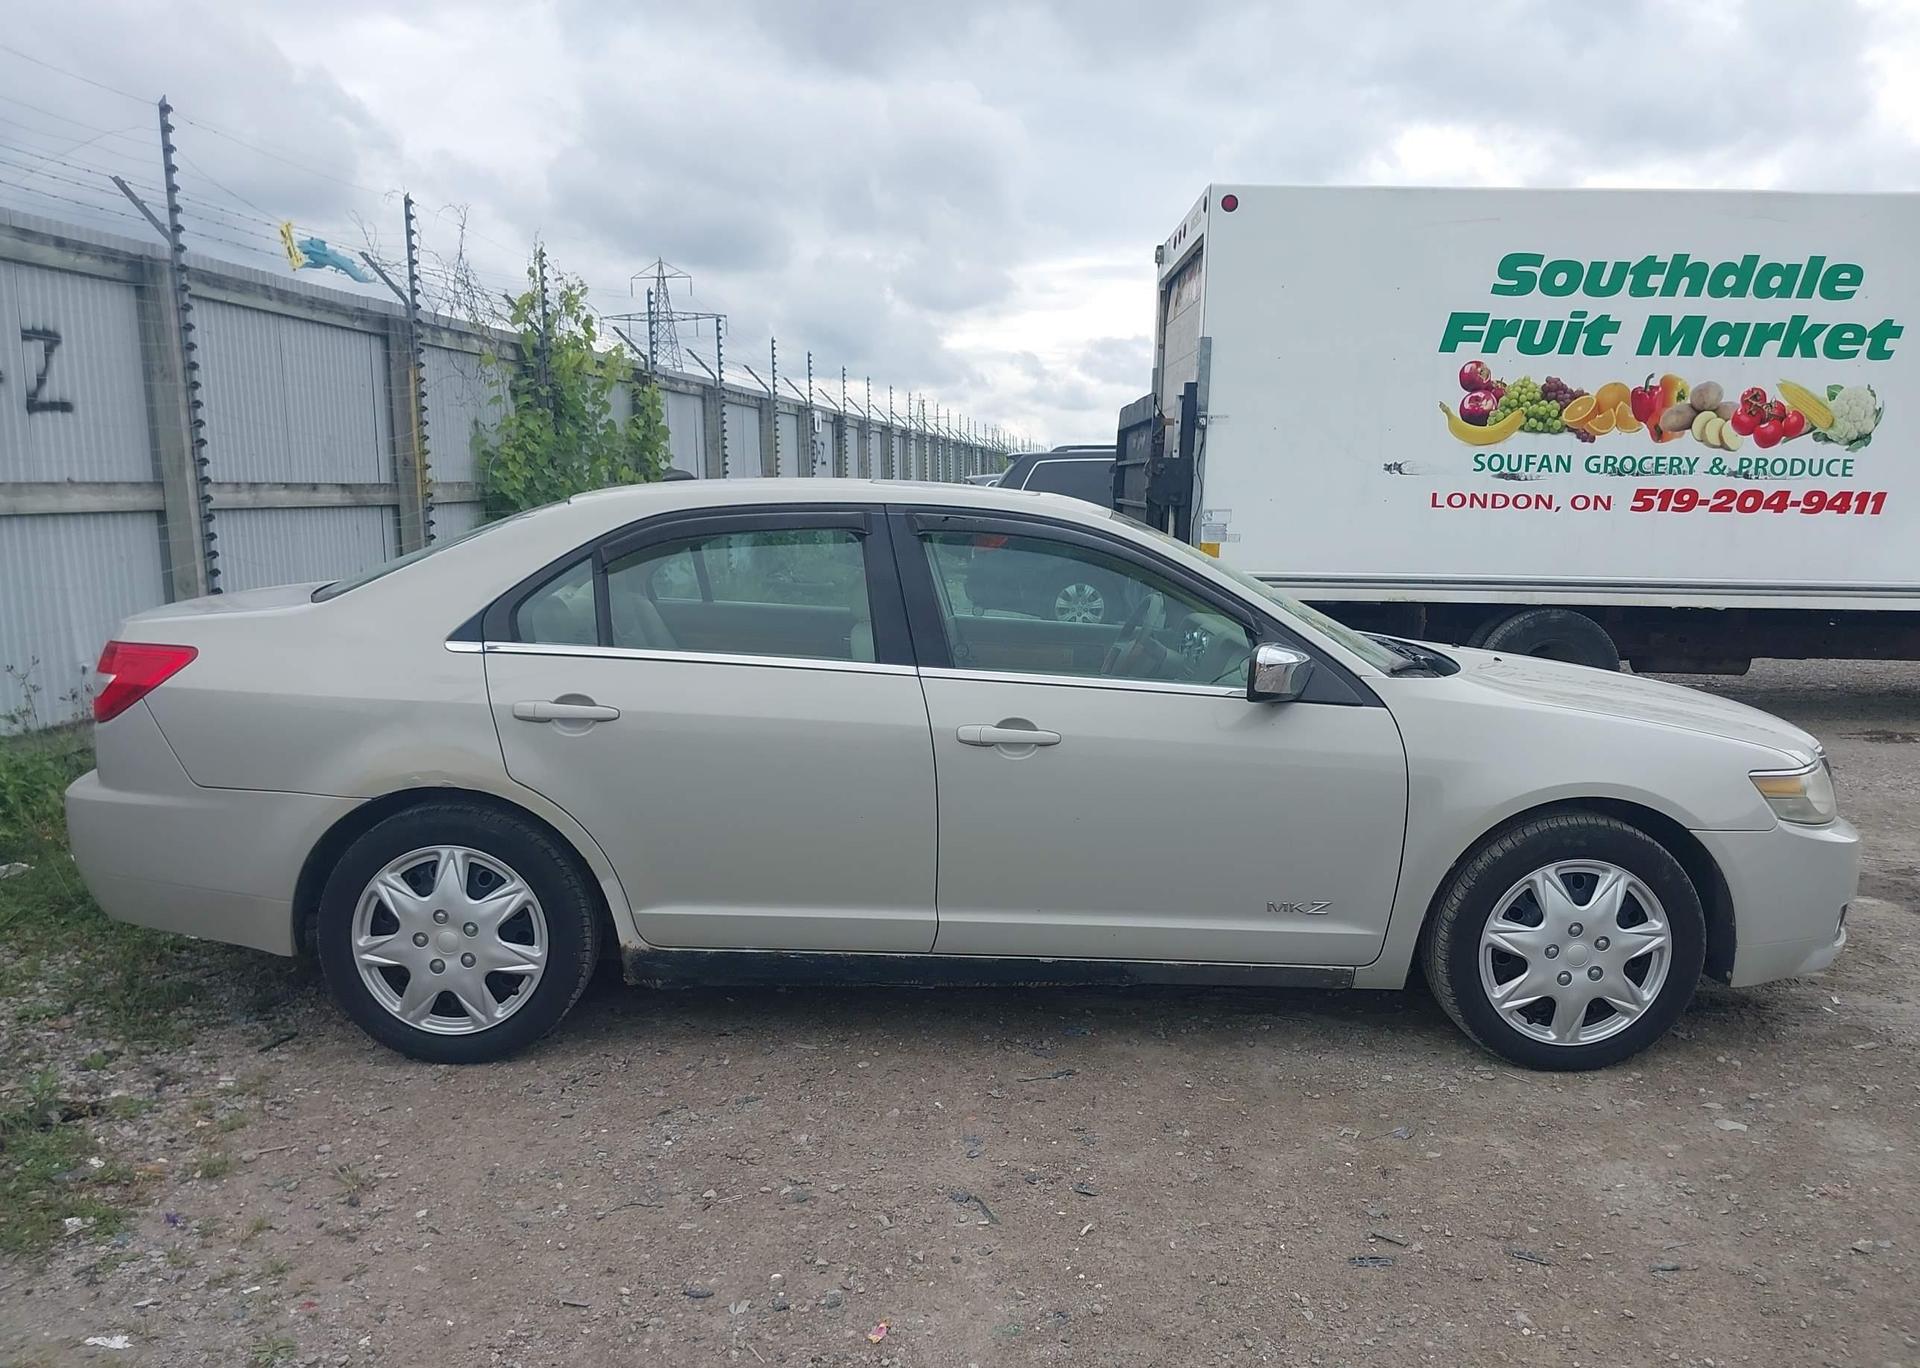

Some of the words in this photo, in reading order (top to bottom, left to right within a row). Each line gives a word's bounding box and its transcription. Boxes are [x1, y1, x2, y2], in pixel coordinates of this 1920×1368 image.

[1490, 252, 1866, 301] Southdale
[1438, 310, 1621, 357] Fruit
[1634, 314, 1905, 361] Market
[1472, 453, 1573, 474] SOUFAN
[1583, 455, 1700, 476] GROCERY
[1709, 456, 1728, 476] &
[1737, 457, 1856, 478] PRODUCE
[1430, 491, 1561, 513] LONDON,
[1569, 494, 1613, 511] ON
[1629, 488, 1888, 516] 519-204-9411
[1265, 900, 1333, 916] MKZ
